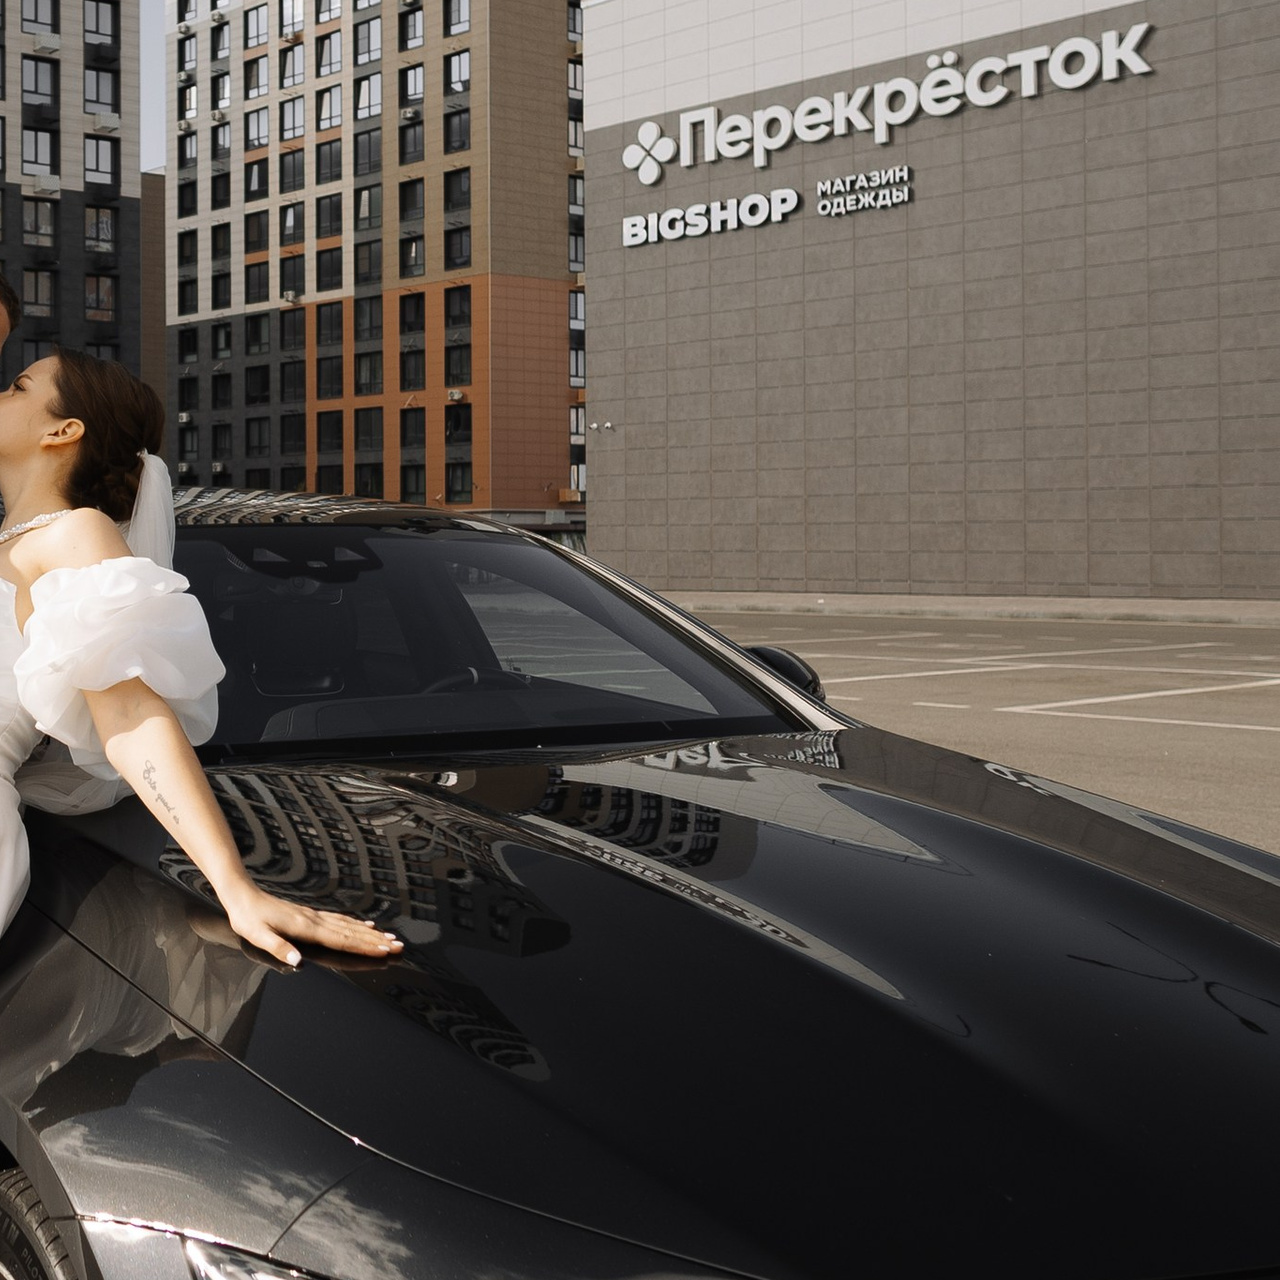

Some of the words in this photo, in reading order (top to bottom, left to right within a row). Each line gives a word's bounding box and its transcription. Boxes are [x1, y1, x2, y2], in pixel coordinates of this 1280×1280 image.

[679, 22, 1154, 168] Перекрёсток
[817, 165, 910, 197] МАГАЗИН
[817, 185, 910, 217] ОДЕЖДЫ
[622, 188, 798, 247] BIGSHOP
